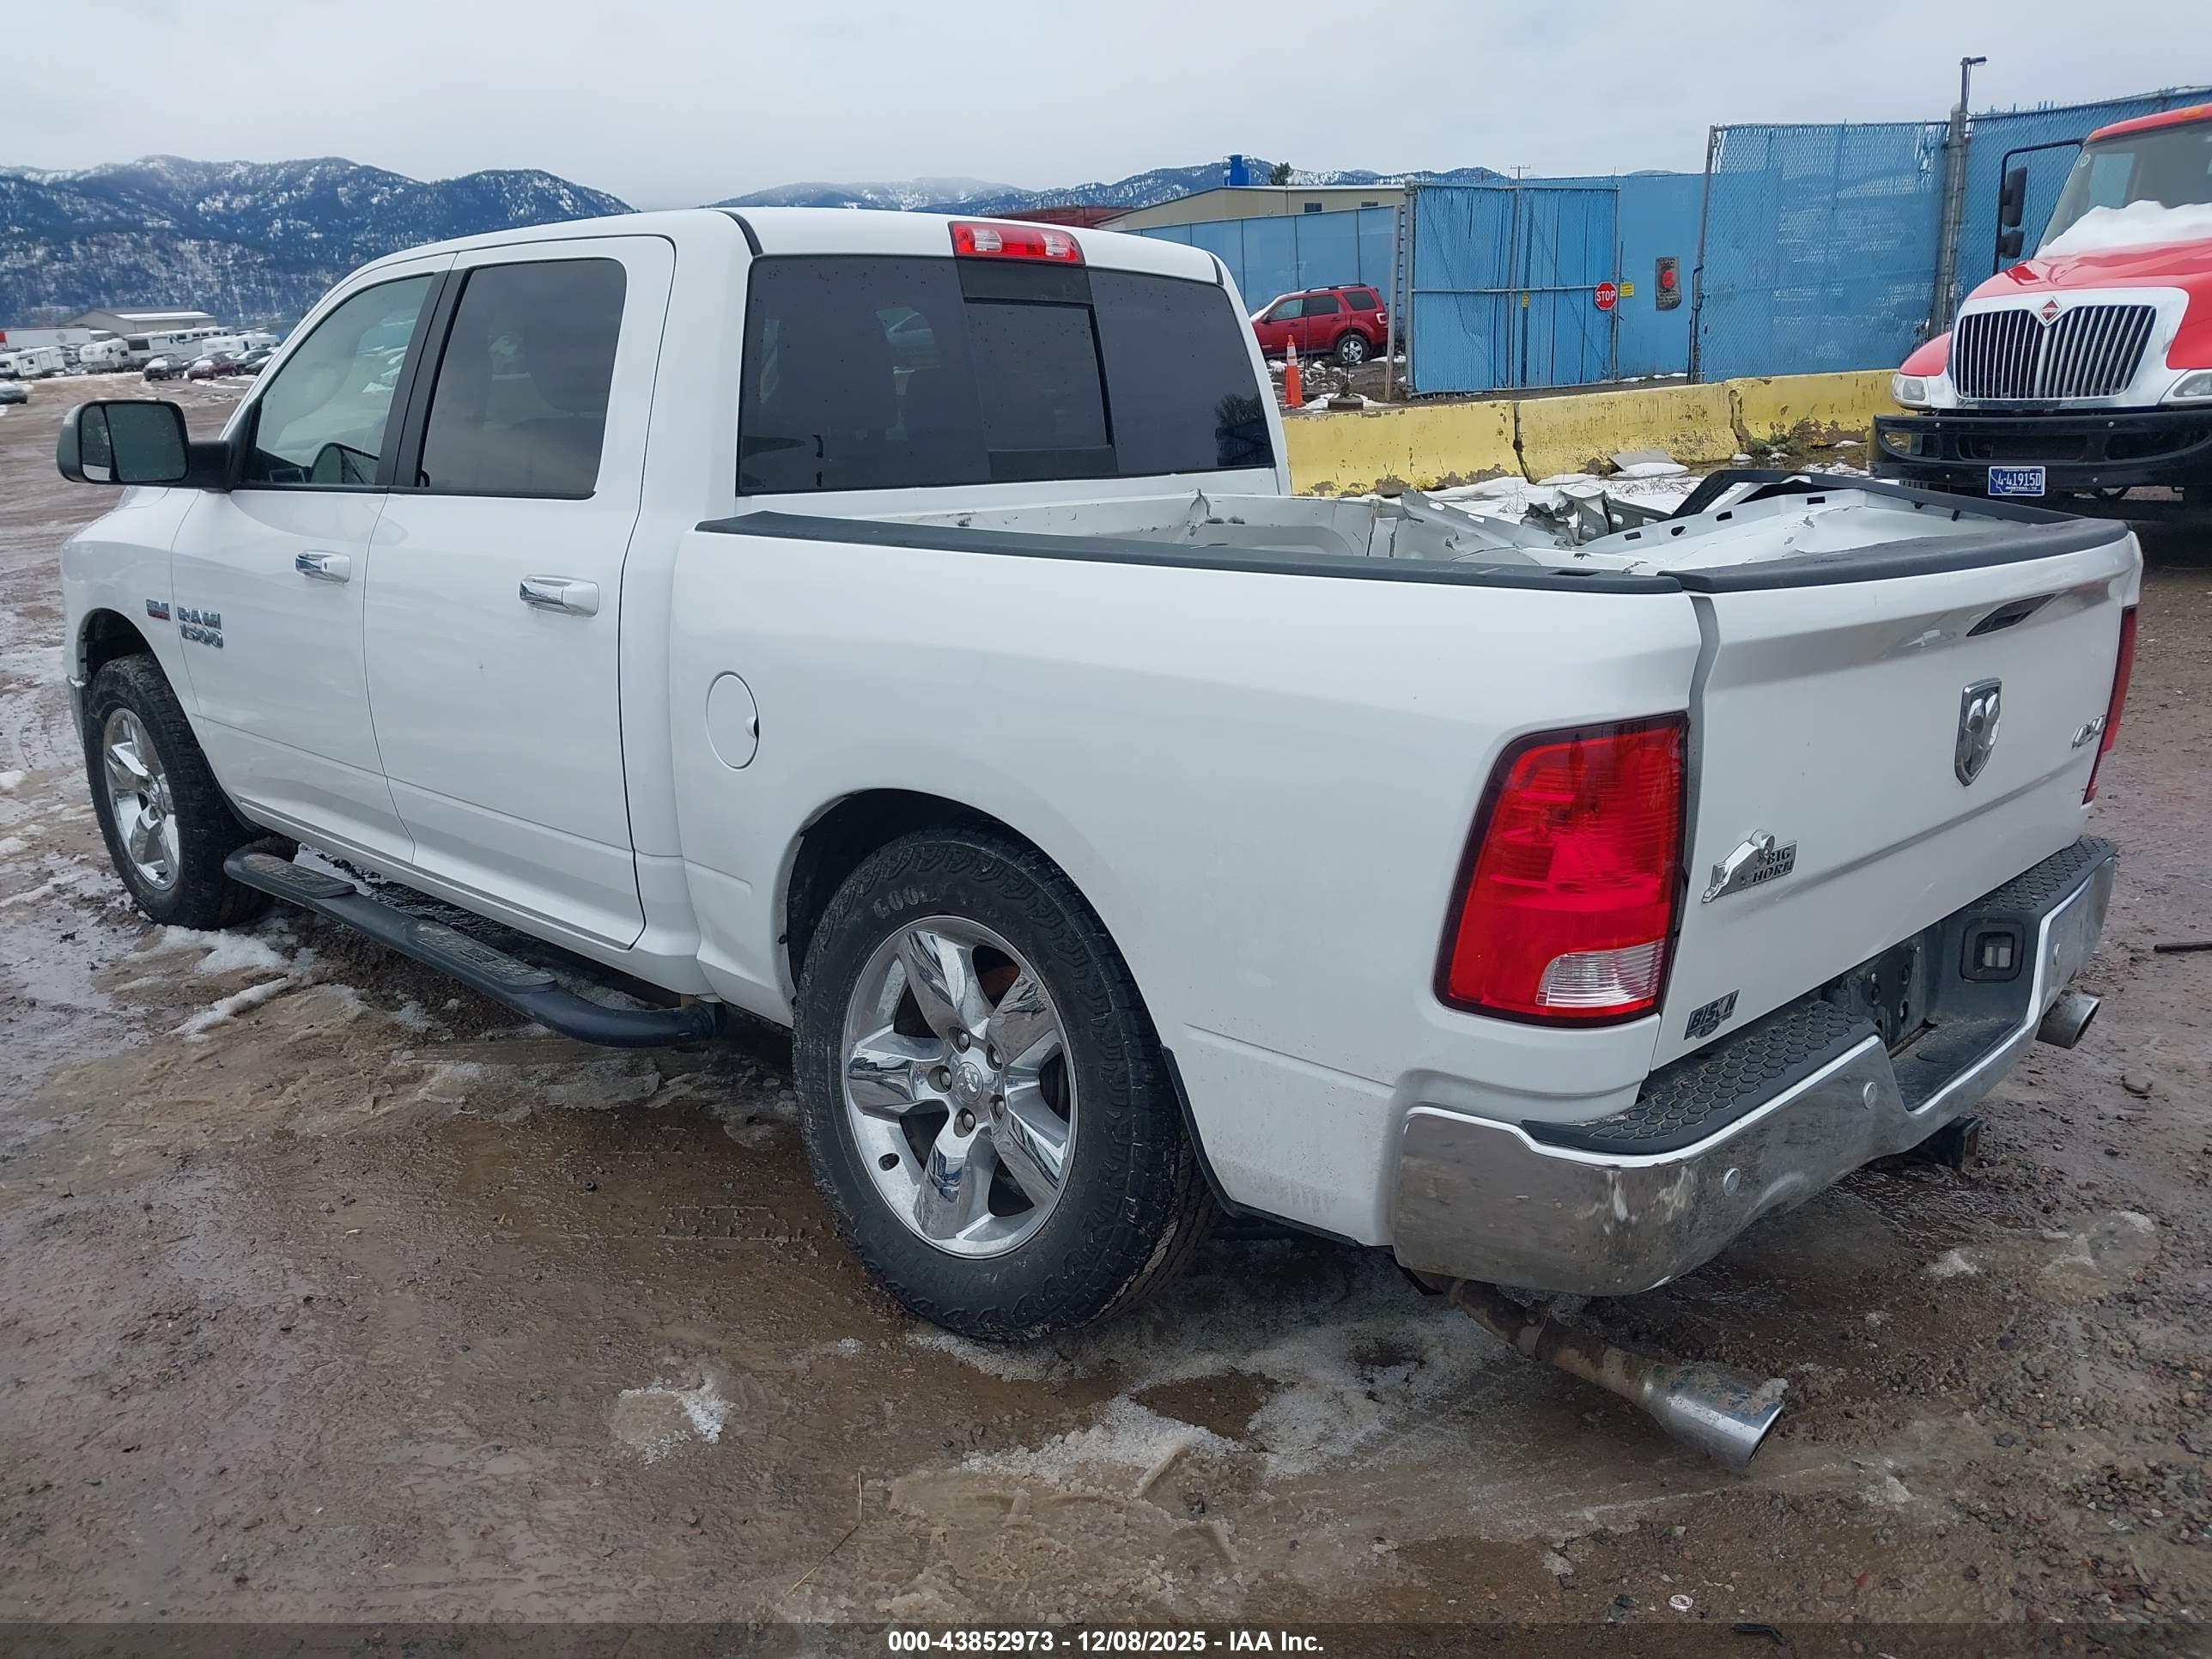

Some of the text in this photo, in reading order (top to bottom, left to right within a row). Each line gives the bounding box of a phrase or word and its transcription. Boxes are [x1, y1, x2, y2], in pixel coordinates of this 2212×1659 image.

[1596, 289, 1616, 302] STOP
[177, 606, 222, 630] RAM
[1765, 847, 1790, 866] BIG
[1753, 860, 1793, 883] HORN
